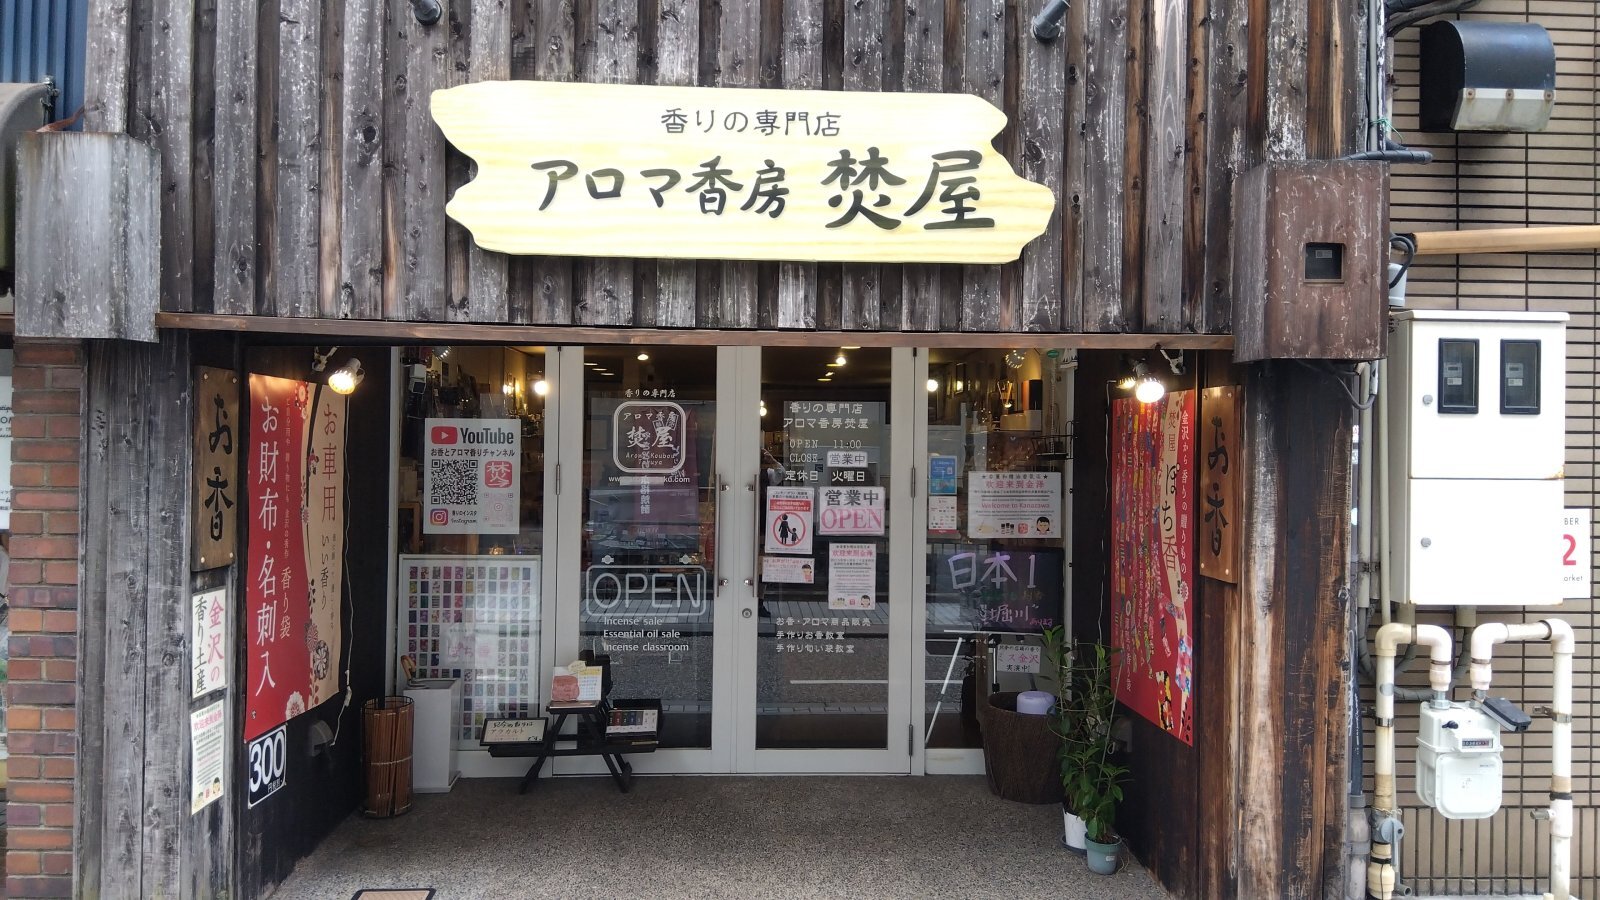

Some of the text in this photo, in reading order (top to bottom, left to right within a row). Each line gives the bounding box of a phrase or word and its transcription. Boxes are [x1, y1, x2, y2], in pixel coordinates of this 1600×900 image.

[660, 107, 843, 138] 香りの専門店
[530, 146, 996, 231] アロマ香房 焚屋
[624, 388, 677, 399] 香りの専門店
[789, 401, 864, 415] 香りの専門店
[783, 417, 869, 429] アロマ香房焚屋
[459, 427, 514, 445] YouTube
[626, 426, 674, 449] 焚屋
[789, 439, 862, 449] OPEN 11:00
[204, 393, 234, 542] お香
[321, 402, 338, 523] お車用
[789, 453, 819, 463] CLOSE
[829, 454, 866, 465] 営業中
[785, 470, 866, 482] 定休日 火曜日
[1204, 415, 1230, 557] お香
[825, 489, 880, 507] 営業中
[821, 508, 884, 530] OPEN
[255, 396, 280, 697] お財布・名刺入
[1562, 533, 1577, 566] 2
[592, 572, 702, 609] OPEN
[603, 616, 664, 626] Incense sale
[207, 594, 225, 684] 金沢の
[603, 629, 681, 639] Essential oil sale
[775, 630, 846, 640] 手作りお香教室
[193, 595, 208, 695] 香り土産
[603, 642, 690, 652] Incense classroom
[249, 731, 285, 793] 300
